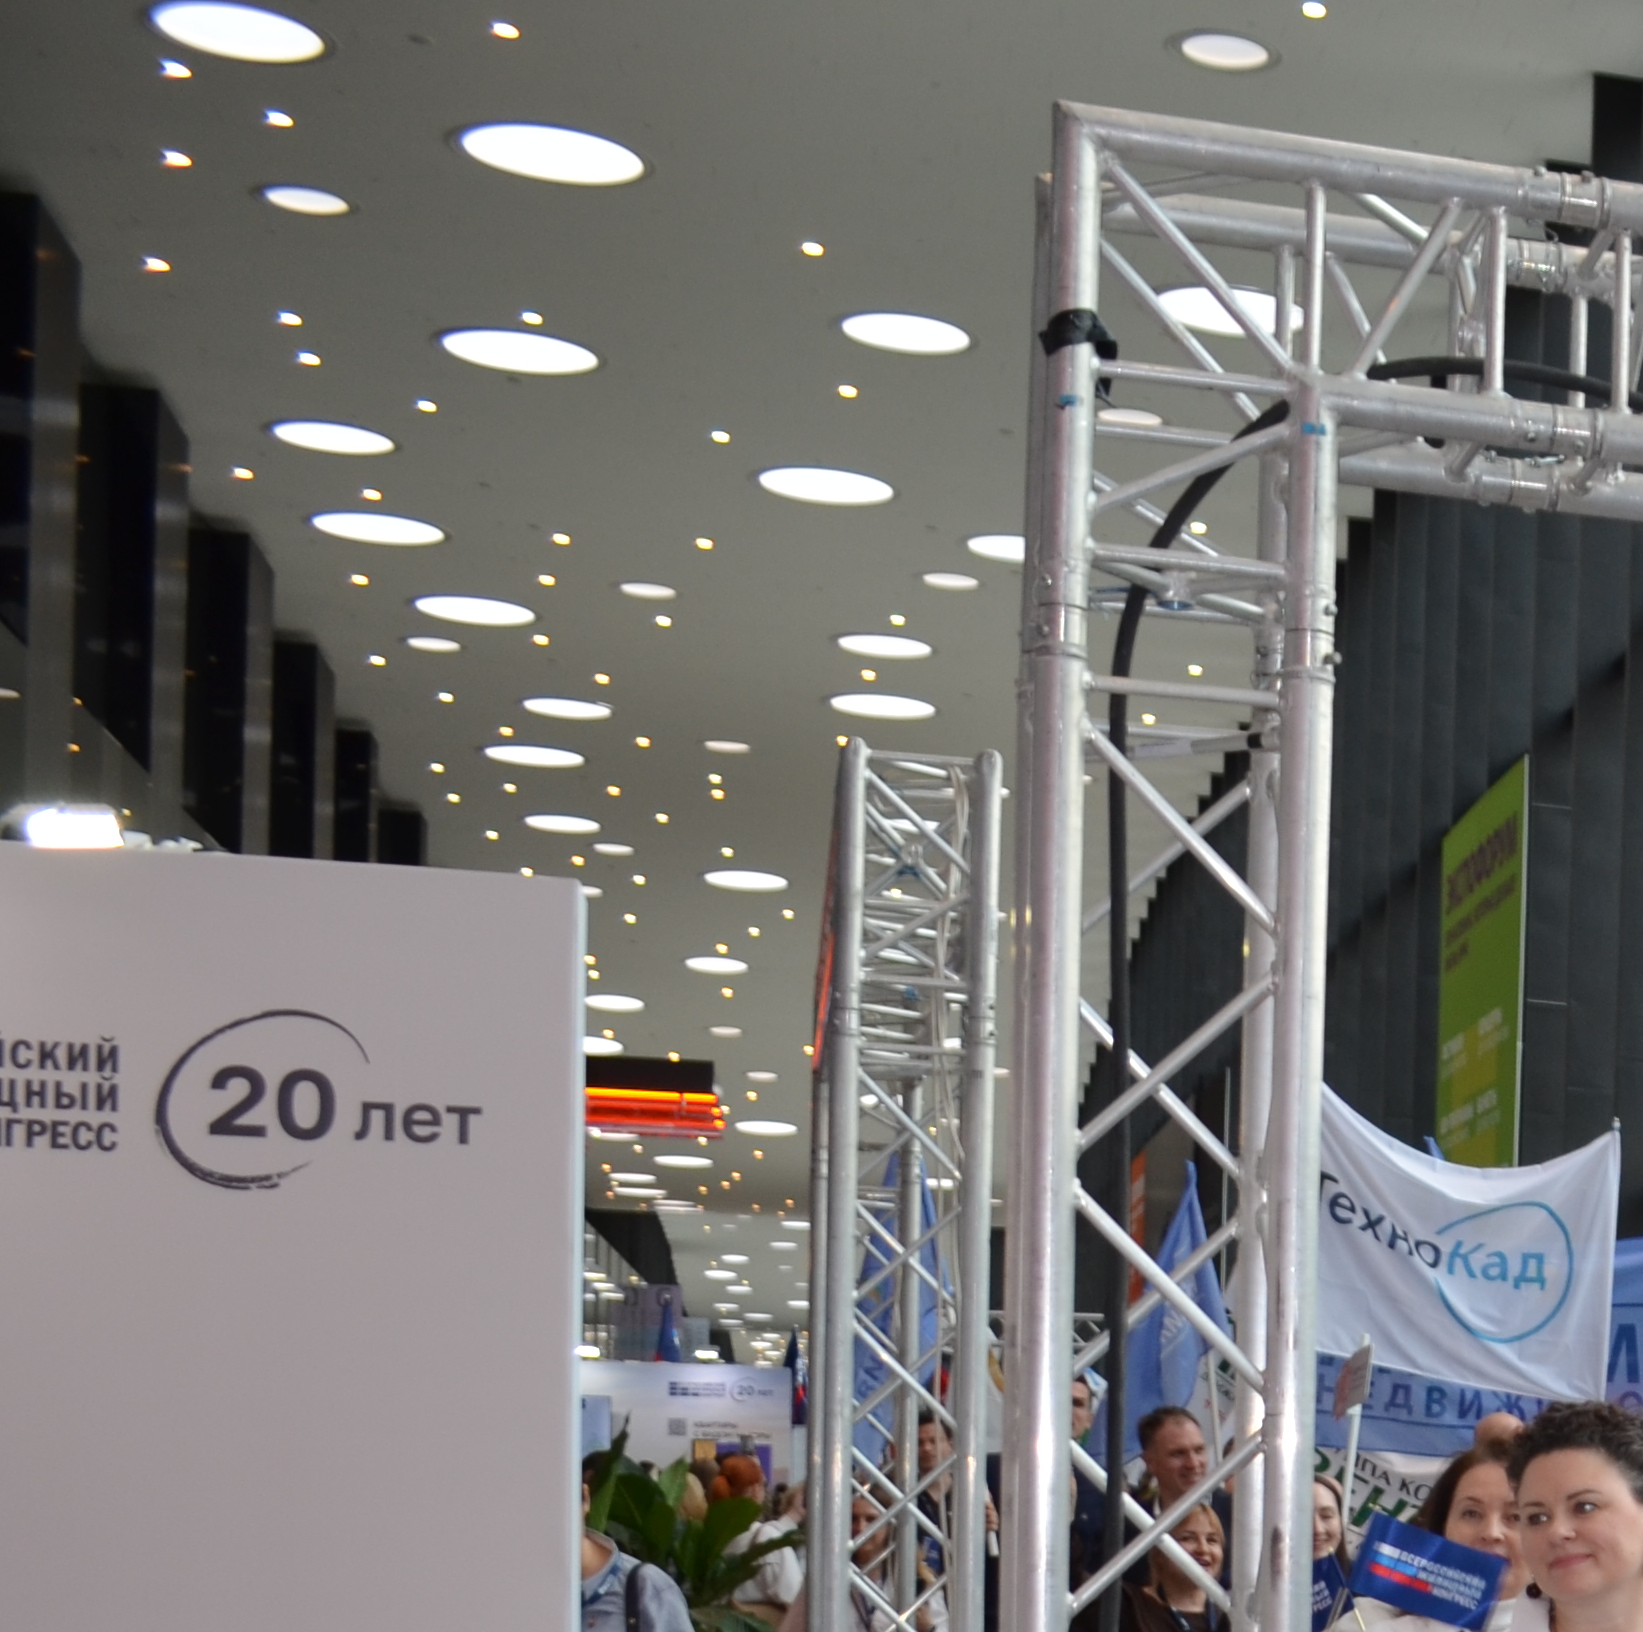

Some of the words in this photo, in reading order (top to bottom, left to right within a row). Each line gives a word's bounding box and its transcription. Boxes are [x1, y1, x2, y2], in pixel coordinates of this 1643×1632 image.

[209, 1064, 336, 1141] 20
[353, 1098, 483, 1146] лет
[0, 1117, 118, 1152] ГРЕСС
